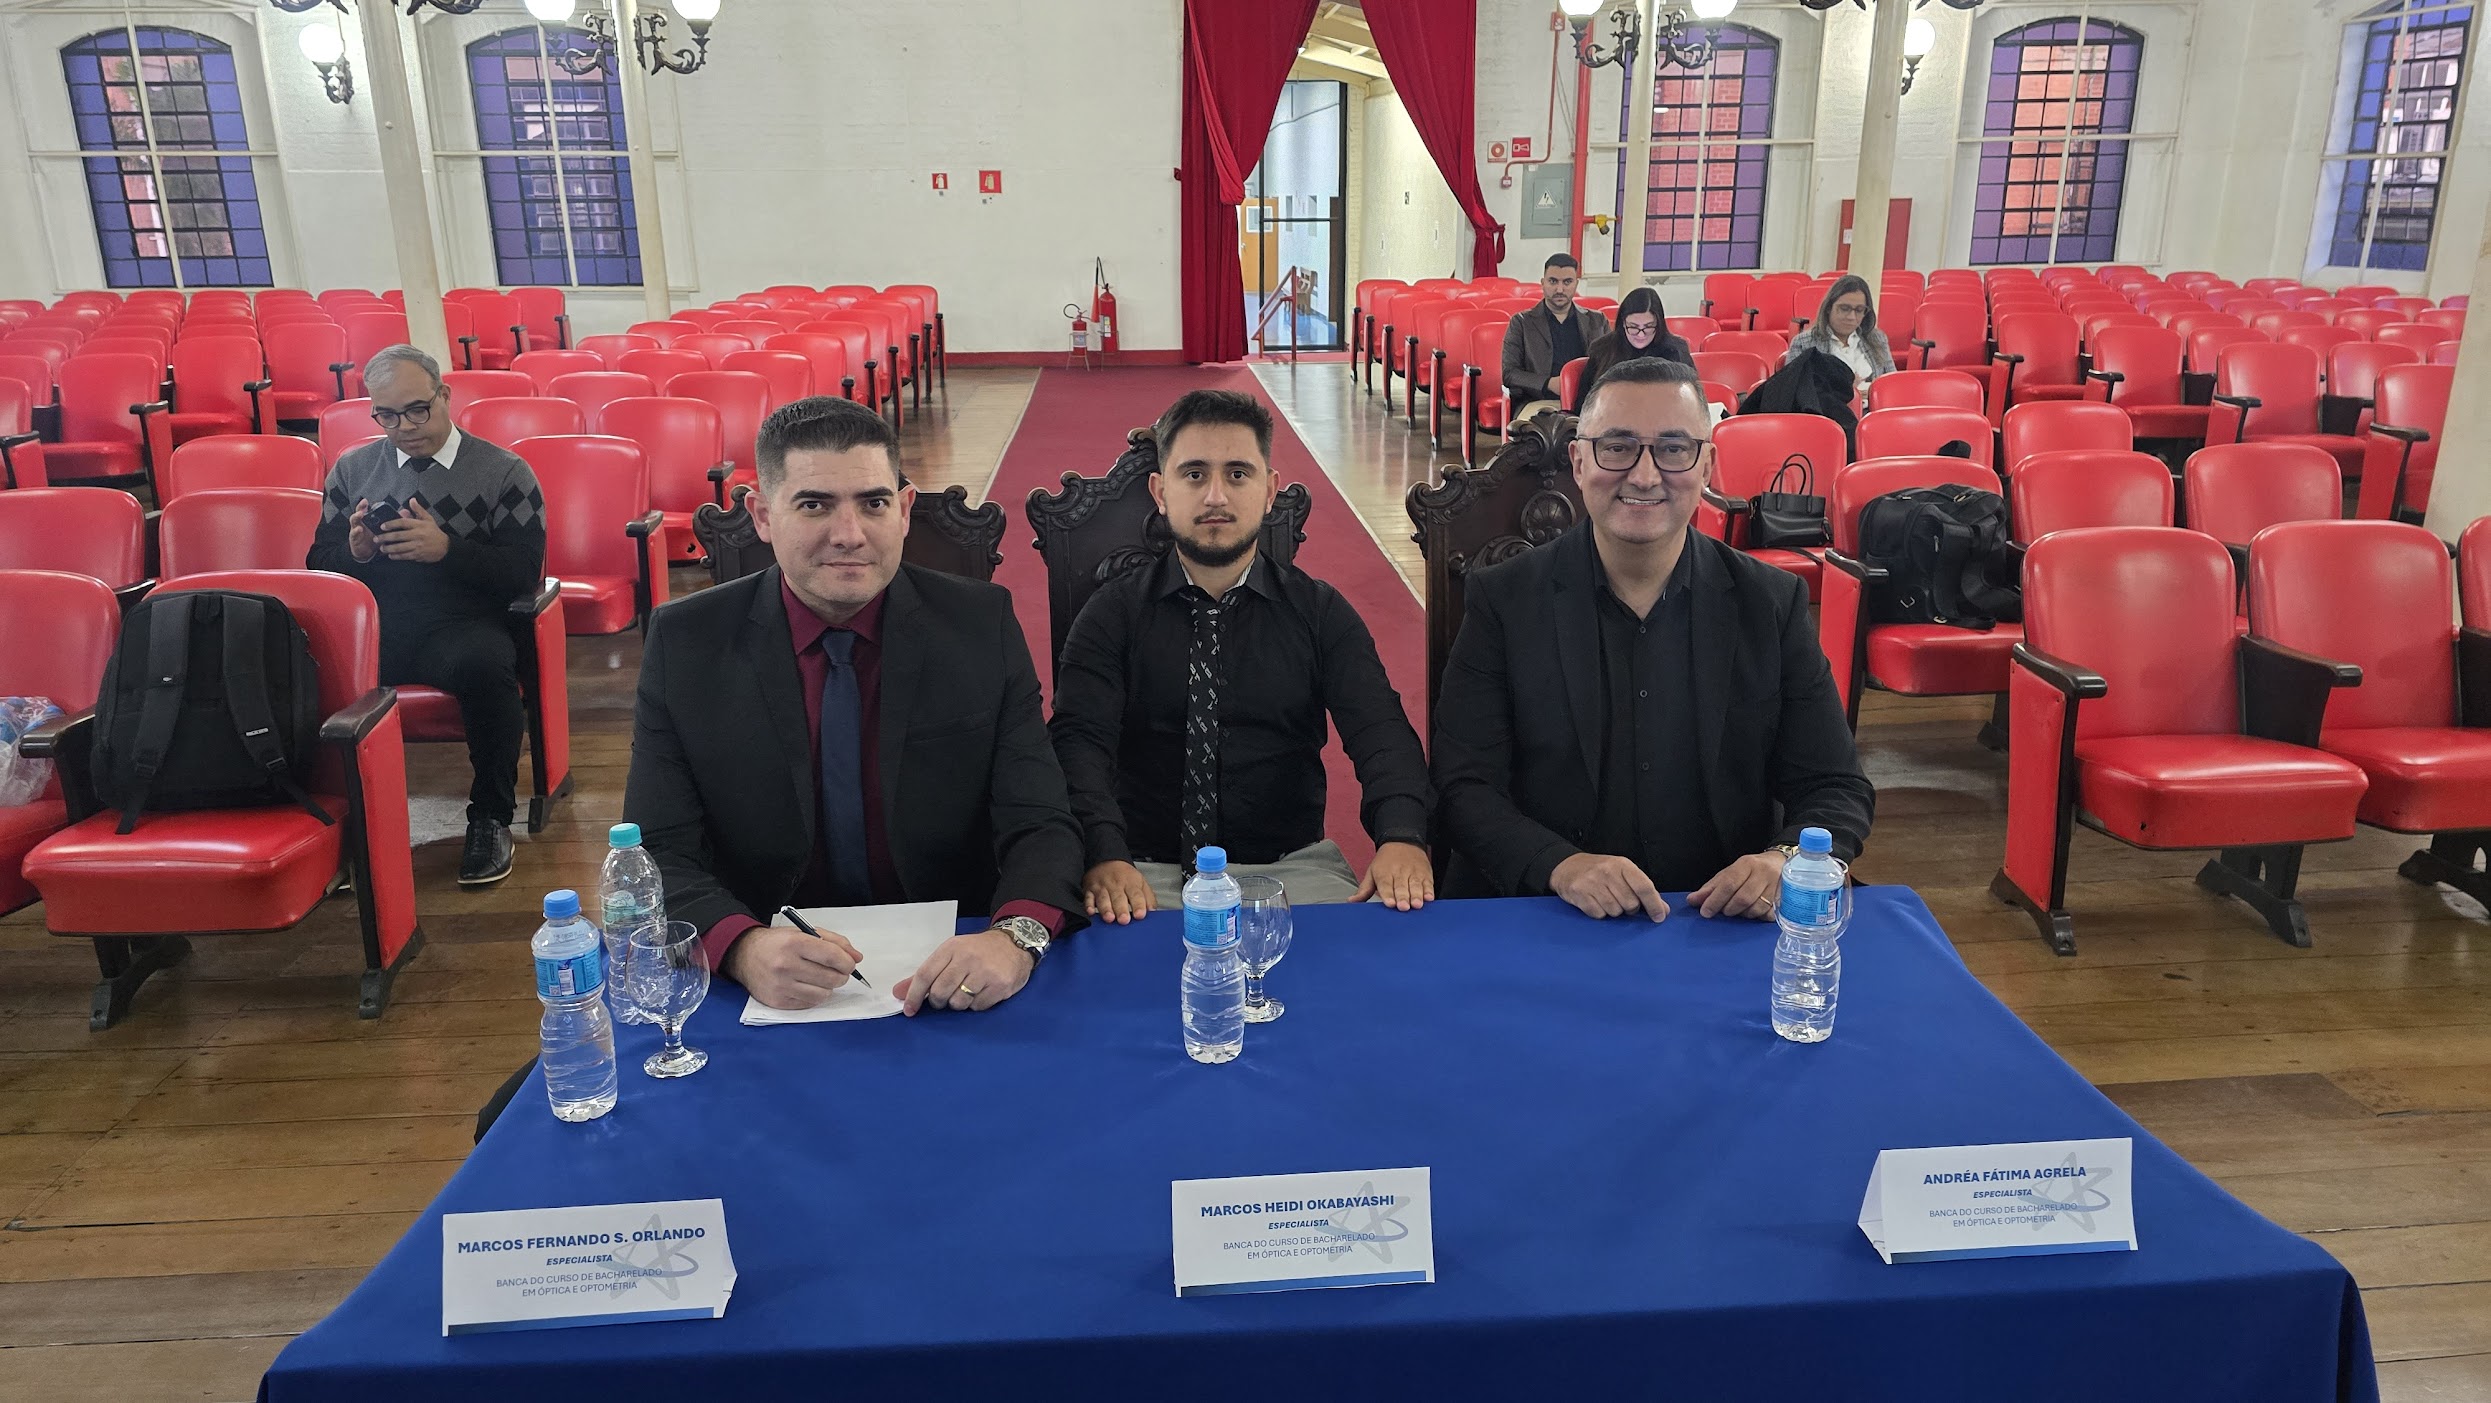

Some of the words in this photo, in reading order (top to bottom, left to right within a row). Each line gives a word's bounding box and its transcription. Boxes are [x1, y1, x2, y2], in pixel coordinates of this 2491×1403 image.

[1923, 1170, 1979, 1184] ANDRÉA
[1983, 1168, 2031, 1181] FÁTIMA
[2034, 1167, 2086, 1179] AGRELA
[1973, 1189, 2032, 1198] ESPECIALISTA
[1201, 1203, 1261, 1217] MARCOS
[1265, 1200, 1303, 1212] HEIDI
[1307, 1195, 1394, 1210] OKABAYASHI
[1930, 1209, 1958, 1217] BANCA
[1960, 1208, 1972, 1216] DO
[1974, 1206, 2002, 1215] CURSO
[2018, 1203, 2077, 1212] BACHARELADO
[1268, 1220, 1329, 1229] ESPECIALISTA
[1967, 1216, 1996, 1226] ÓPTICA
[2005, 1215, 2055, 1224] OPTOMETRIA
[458, 1239, 523, 1253] MARCOS
[527, 1234, 610, 1249] FERNANDO
[614, 1232, 628, 1243] S.
[632, 1228, 706, 1242] ORLANDO
[1224, 1241, 1252, 1250] BANCA
[1269, 1237, 1298, 1246] CURSO
[1301, 1236, 1312, 1244] DE
[1314, 1233, 1375, 1243] BACHARELADO
[1247, 1251, 1259, 1259] EM
[1262, 1248, 1292, 1258] ÓPTICA
[1301, 1246, 1352, 1255] OPTOMETRIA
[546, 1255, 613, 1266] ESPECIALISTA
[496, 1278, 528, 1287] BANCA
[530, 1276, 544, 1285] DO
[546, 1273, 579, 1284] CURSO
[581, 1272, 593, 1281] DE
[596, 1268, 662, 1280] BACHARELADO
[523, 1288, 536, 1297] EM
[537, 1284, 571, 1296] ÓPTICA
[573, 1285, 578, 1293] E
[580, 1282, 637, 1292] OPTOMETRIA
